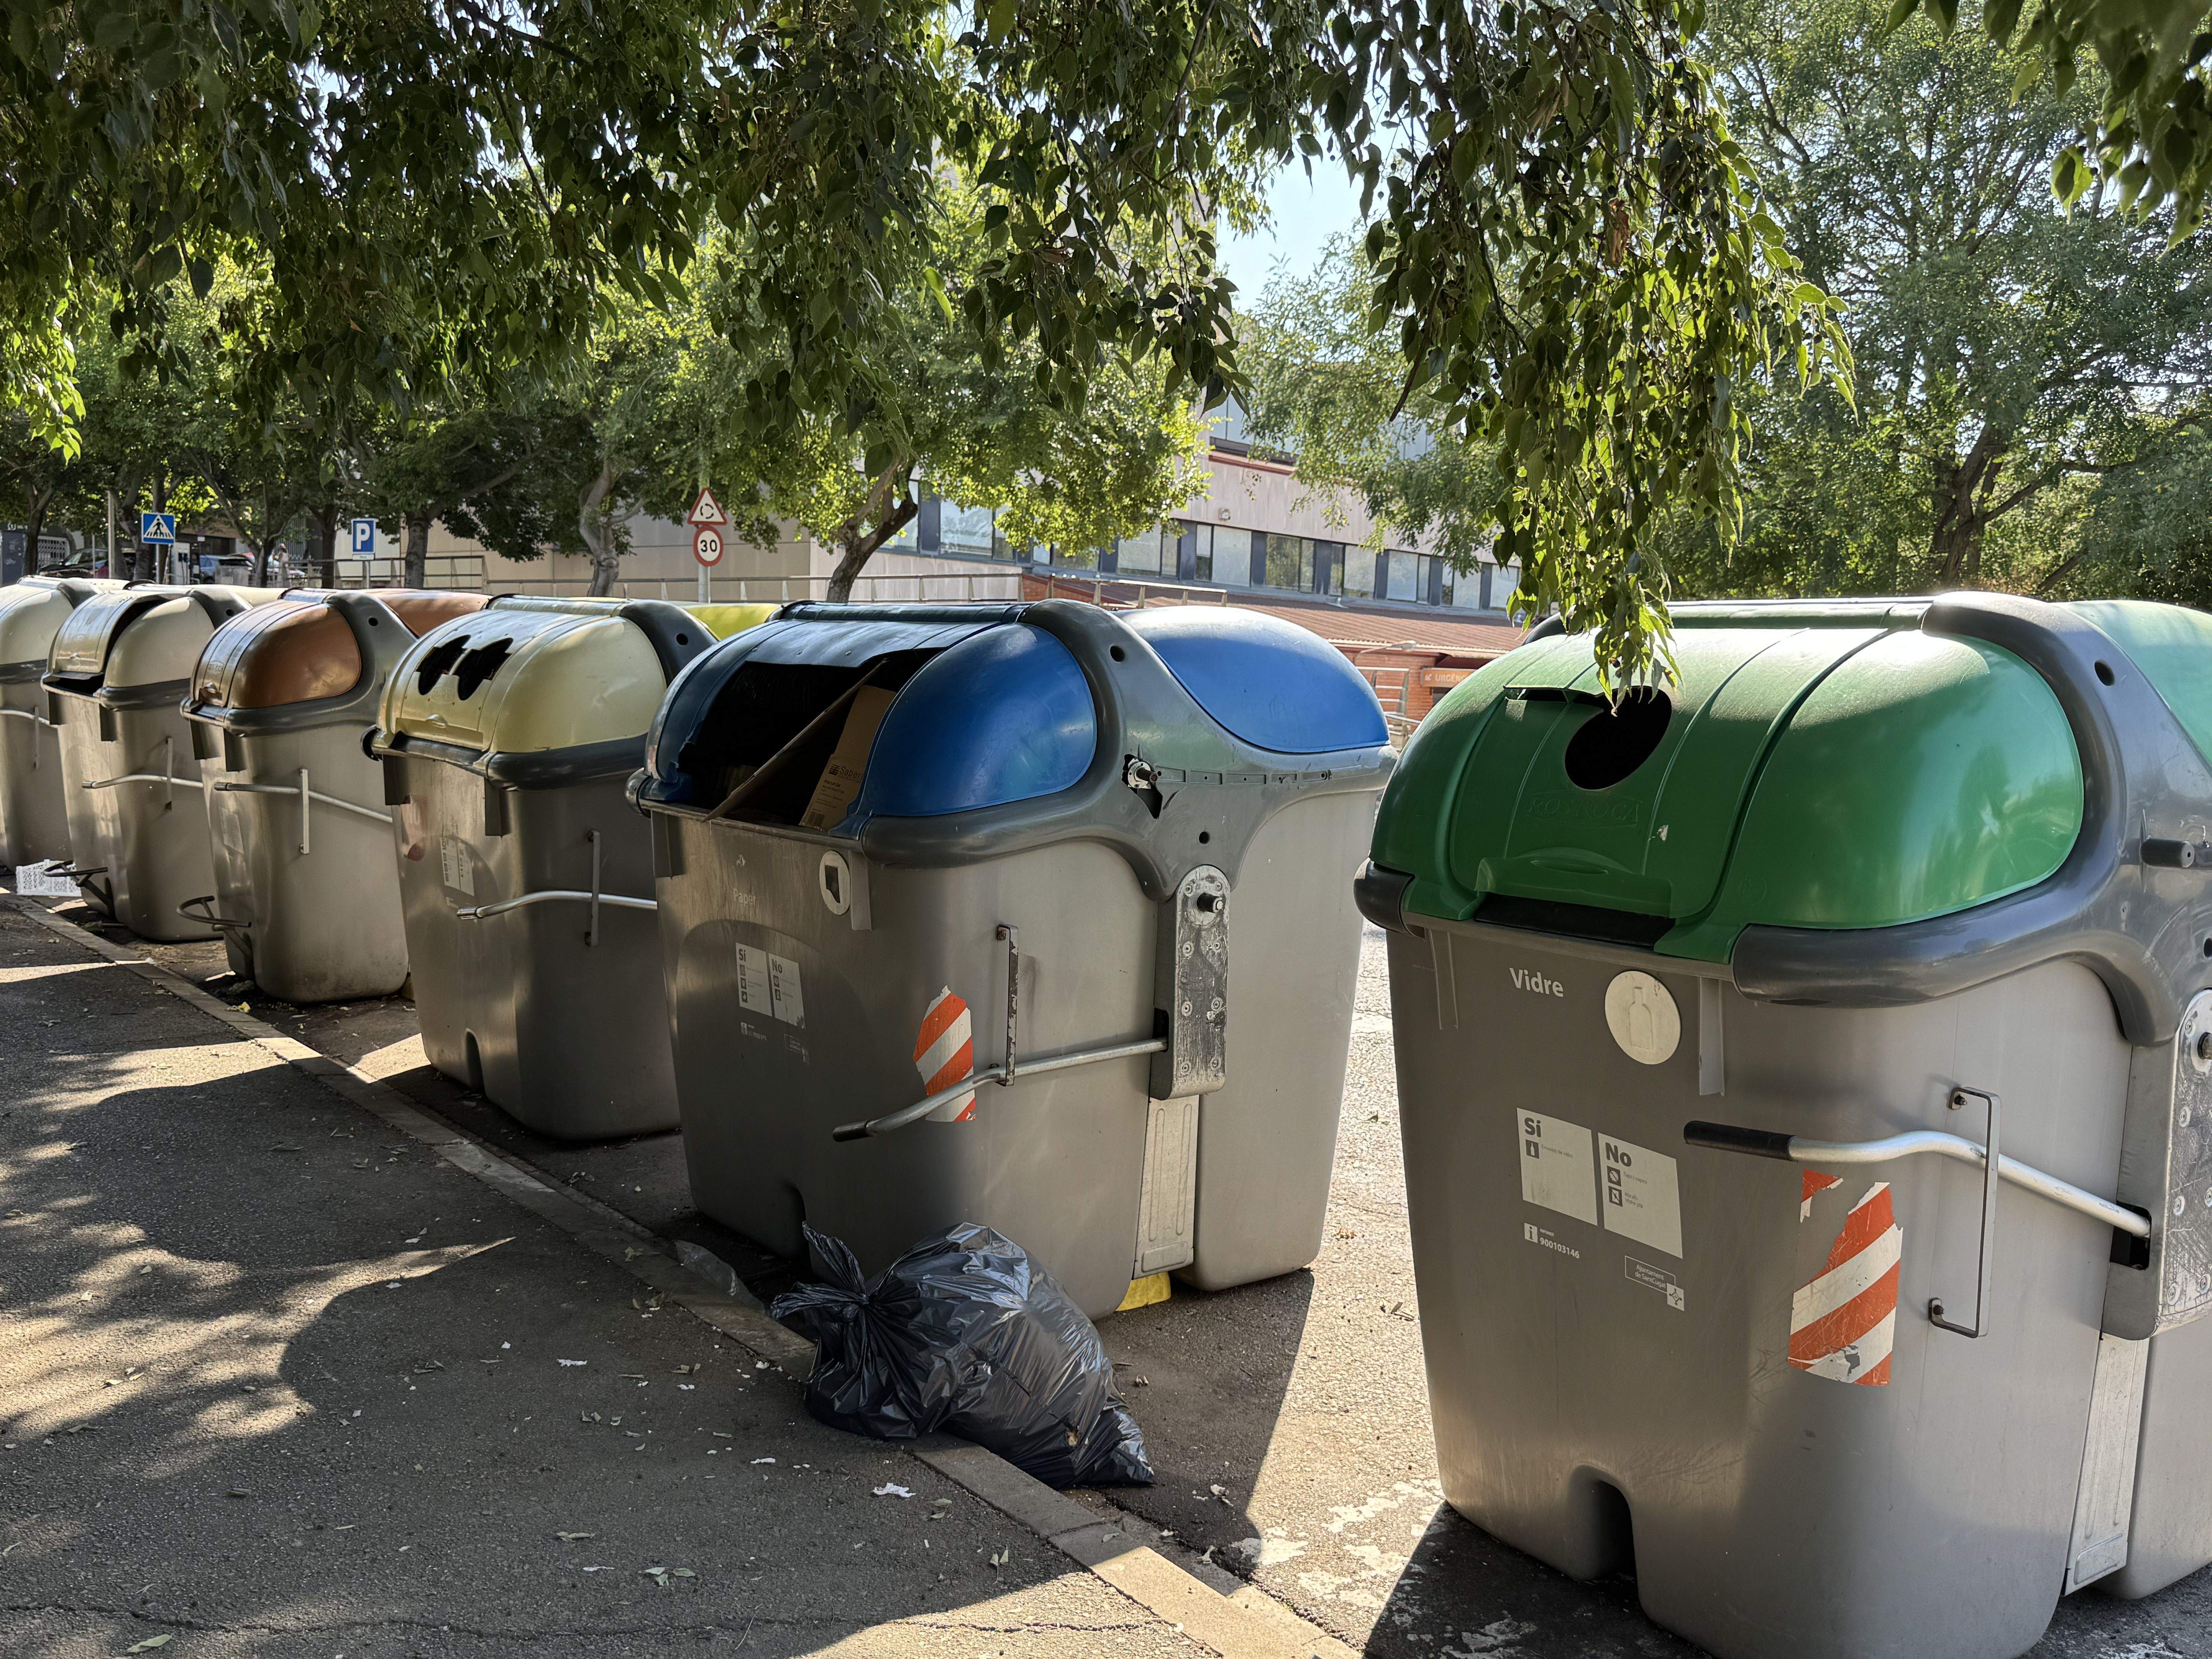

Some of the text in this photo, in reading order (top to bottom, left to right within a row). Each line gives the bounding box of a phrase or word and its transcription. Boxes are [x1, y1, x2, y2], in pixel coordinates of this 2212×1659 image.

[356, 523, 371, 550] P
[700, 539, 717, 552] 30
[733, 888, 756, 908] Paper
[772, 958, 783, 974] No
[1509, 967, 1563, 997] Vidre
[1605, 1142, 1632, 1167] No
[1540, 1237, 1580, 1259] 900103146
[1636, 1264, 1664, 1280] Ajuntament
